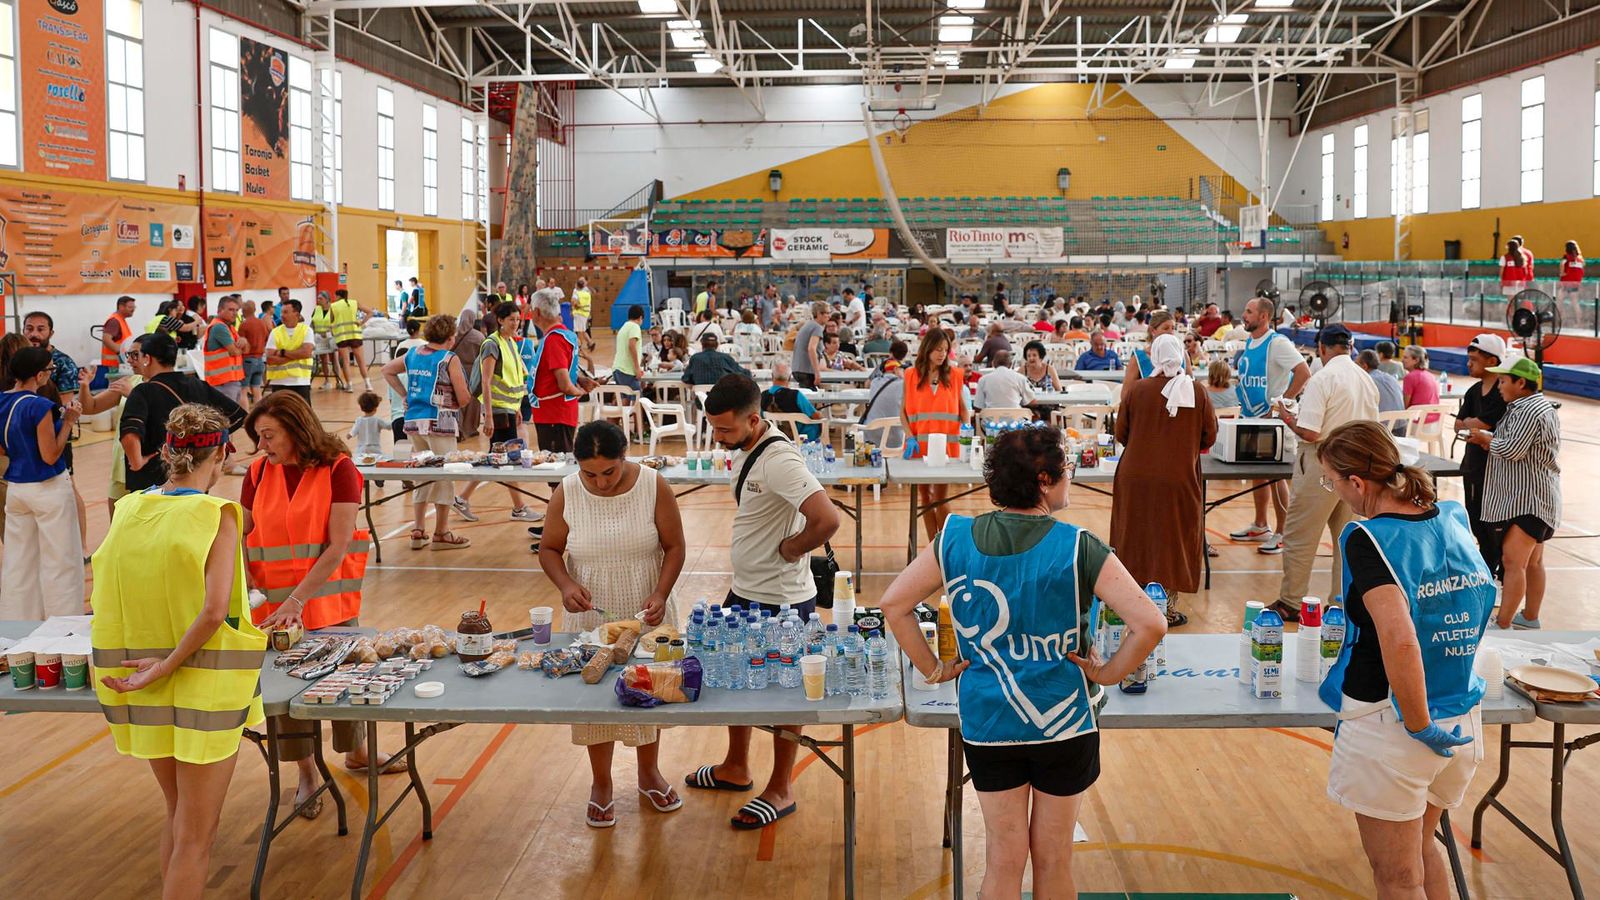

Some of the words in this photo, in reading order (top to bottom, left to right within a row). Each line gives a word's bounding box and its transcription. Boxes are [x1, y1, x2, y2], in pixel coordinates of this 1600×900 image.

[244, 143, 273, 160] Taronja
[244, 162, 270, 177] Basket
[245, 181, 266, 194] Nules
[787, 244, 829, 252] CERAMIC
[1444, 612, 1470, 624] CLUB
[1445, 644, 1476, 656] NULES
